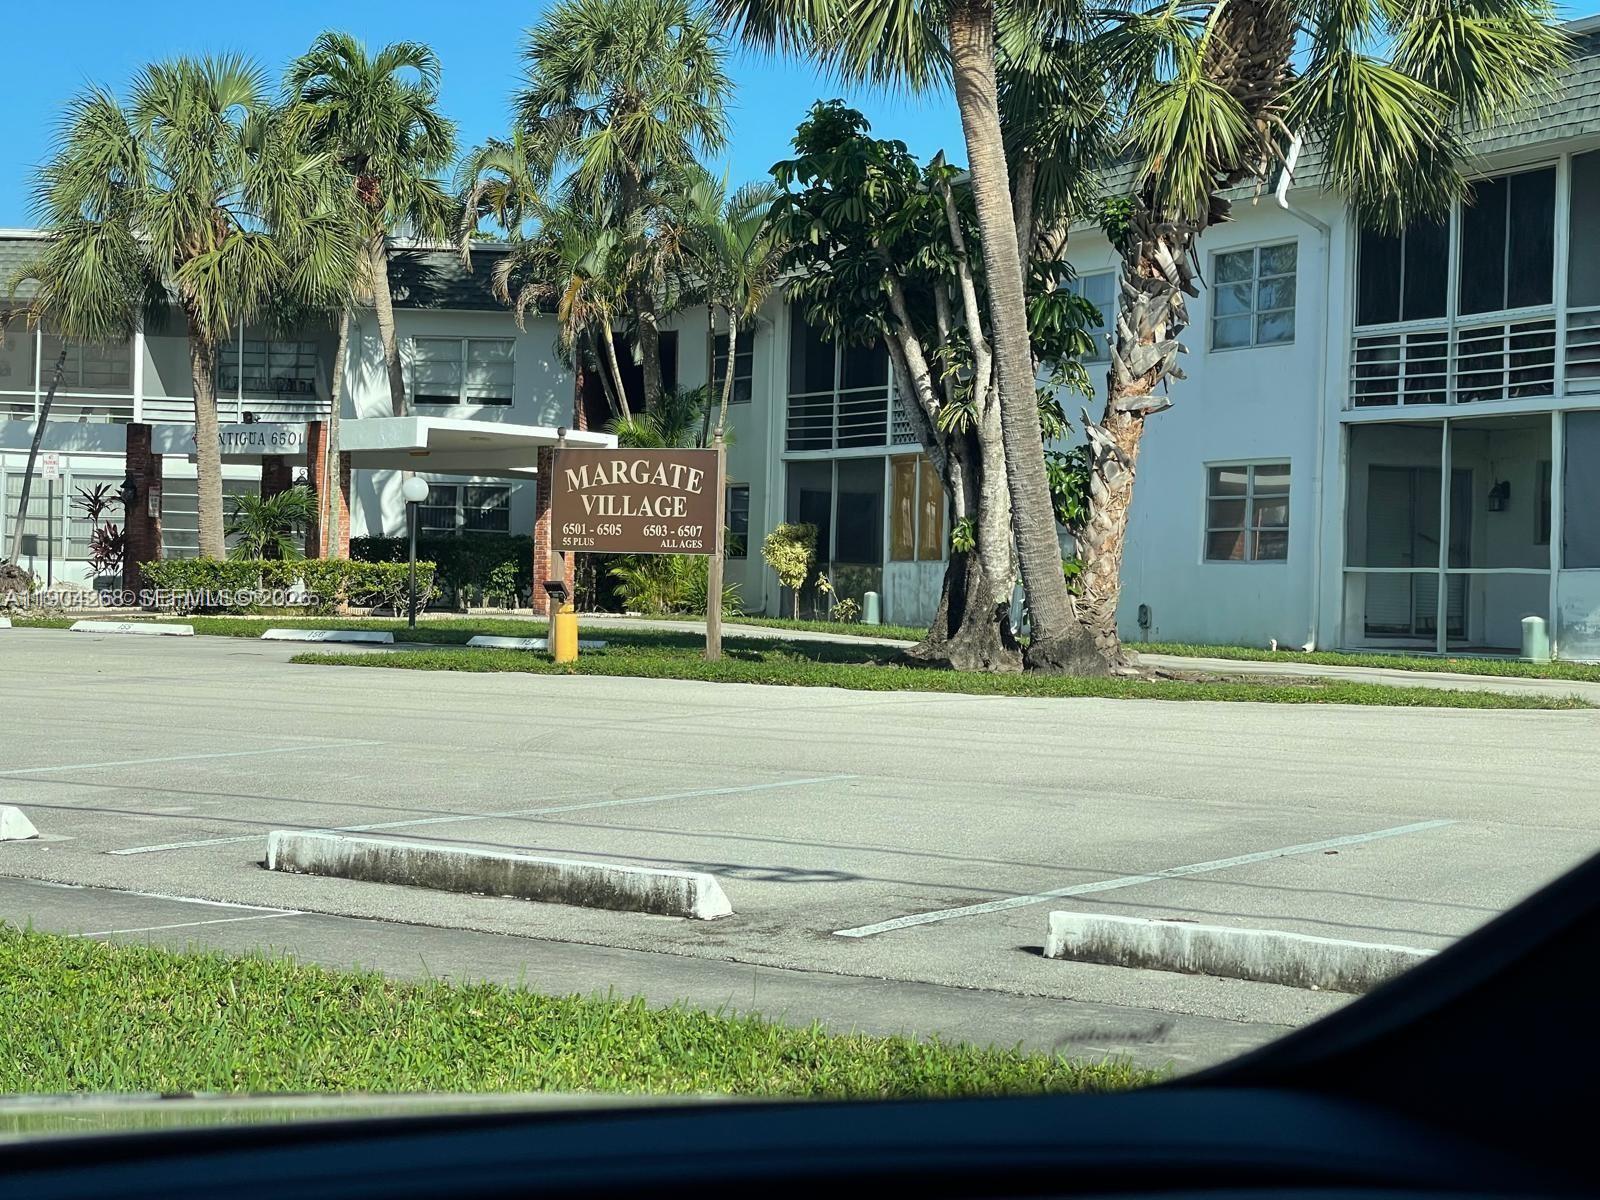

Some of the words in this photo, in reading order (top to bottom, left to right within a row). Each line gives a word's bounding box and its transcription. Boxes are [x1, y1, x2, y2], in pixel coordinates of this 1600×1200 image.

[216, 431, 266, 446] NTIGUA
[271, 432, 302, 446] 6501
[565, 459, 704, 495] MARGATE
[581, 494, 688, 518] VILLAGE
[562, 523, 587, 535] 6501
[596, 524, 622, 536] 6505
[643, 525, 668, 537] 6503
[677, 525, 703, 538] 6507
[562, 537, 572, 546] 55
[573, 537, 595, 546] PLUS
[660, 540, 678, 548] ALL
[679, 540, 703, 549] AGES
